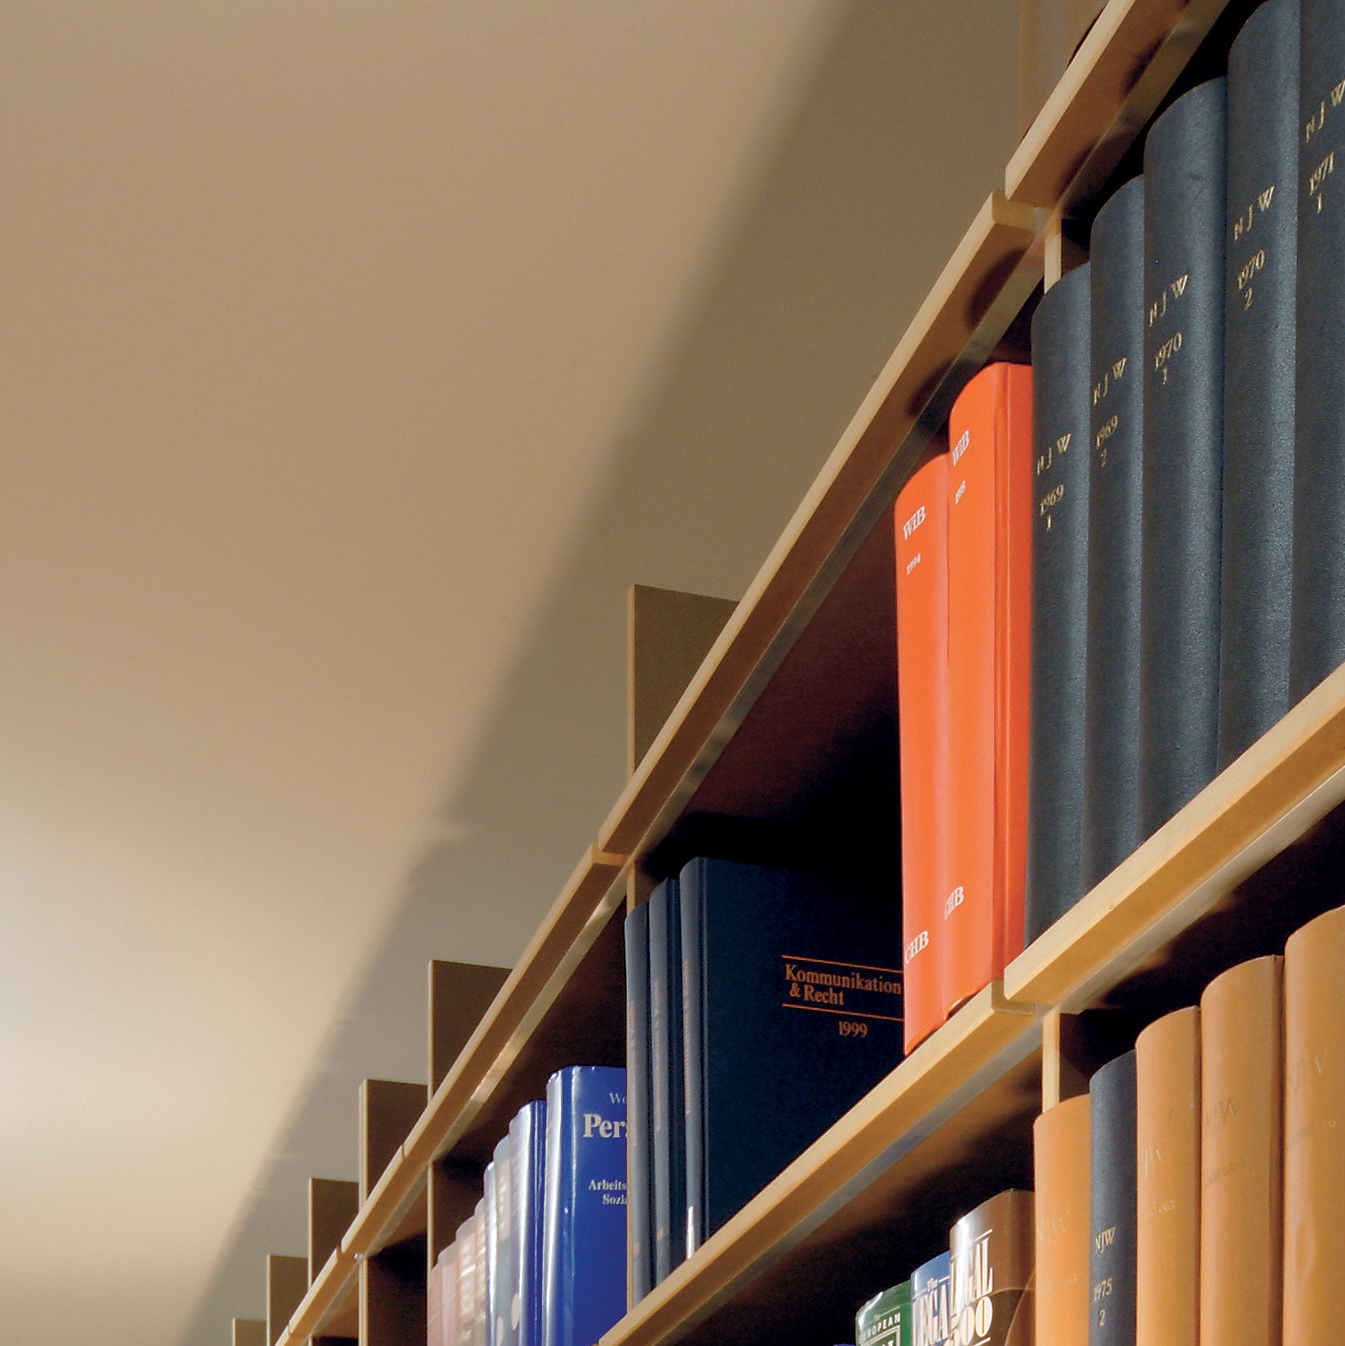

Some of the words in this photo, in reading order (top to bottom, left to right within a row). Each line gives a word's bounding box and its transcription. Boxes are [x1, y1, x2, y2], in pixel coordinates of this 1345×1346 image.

[1309, 152, 1335, 196] 1971
[1237, 249, 1265, 290] 1970
[1244, 287, 1254, 310] 2
[1154, 332, 1183, 371] 1970
[903, 506, 926, 540] WiB
[785, 963, 902, 995] Kommunikation
[789, 985, 801, 999] &
[803, 985, 845, 1006] Recht
[838, 1020, 868, 1038] 1999
[588, 1179, 627, 1191] Arbeits
[602, 1193, 627, 1205] Sozi
[1098, 1309, 1106, 1327] 2
